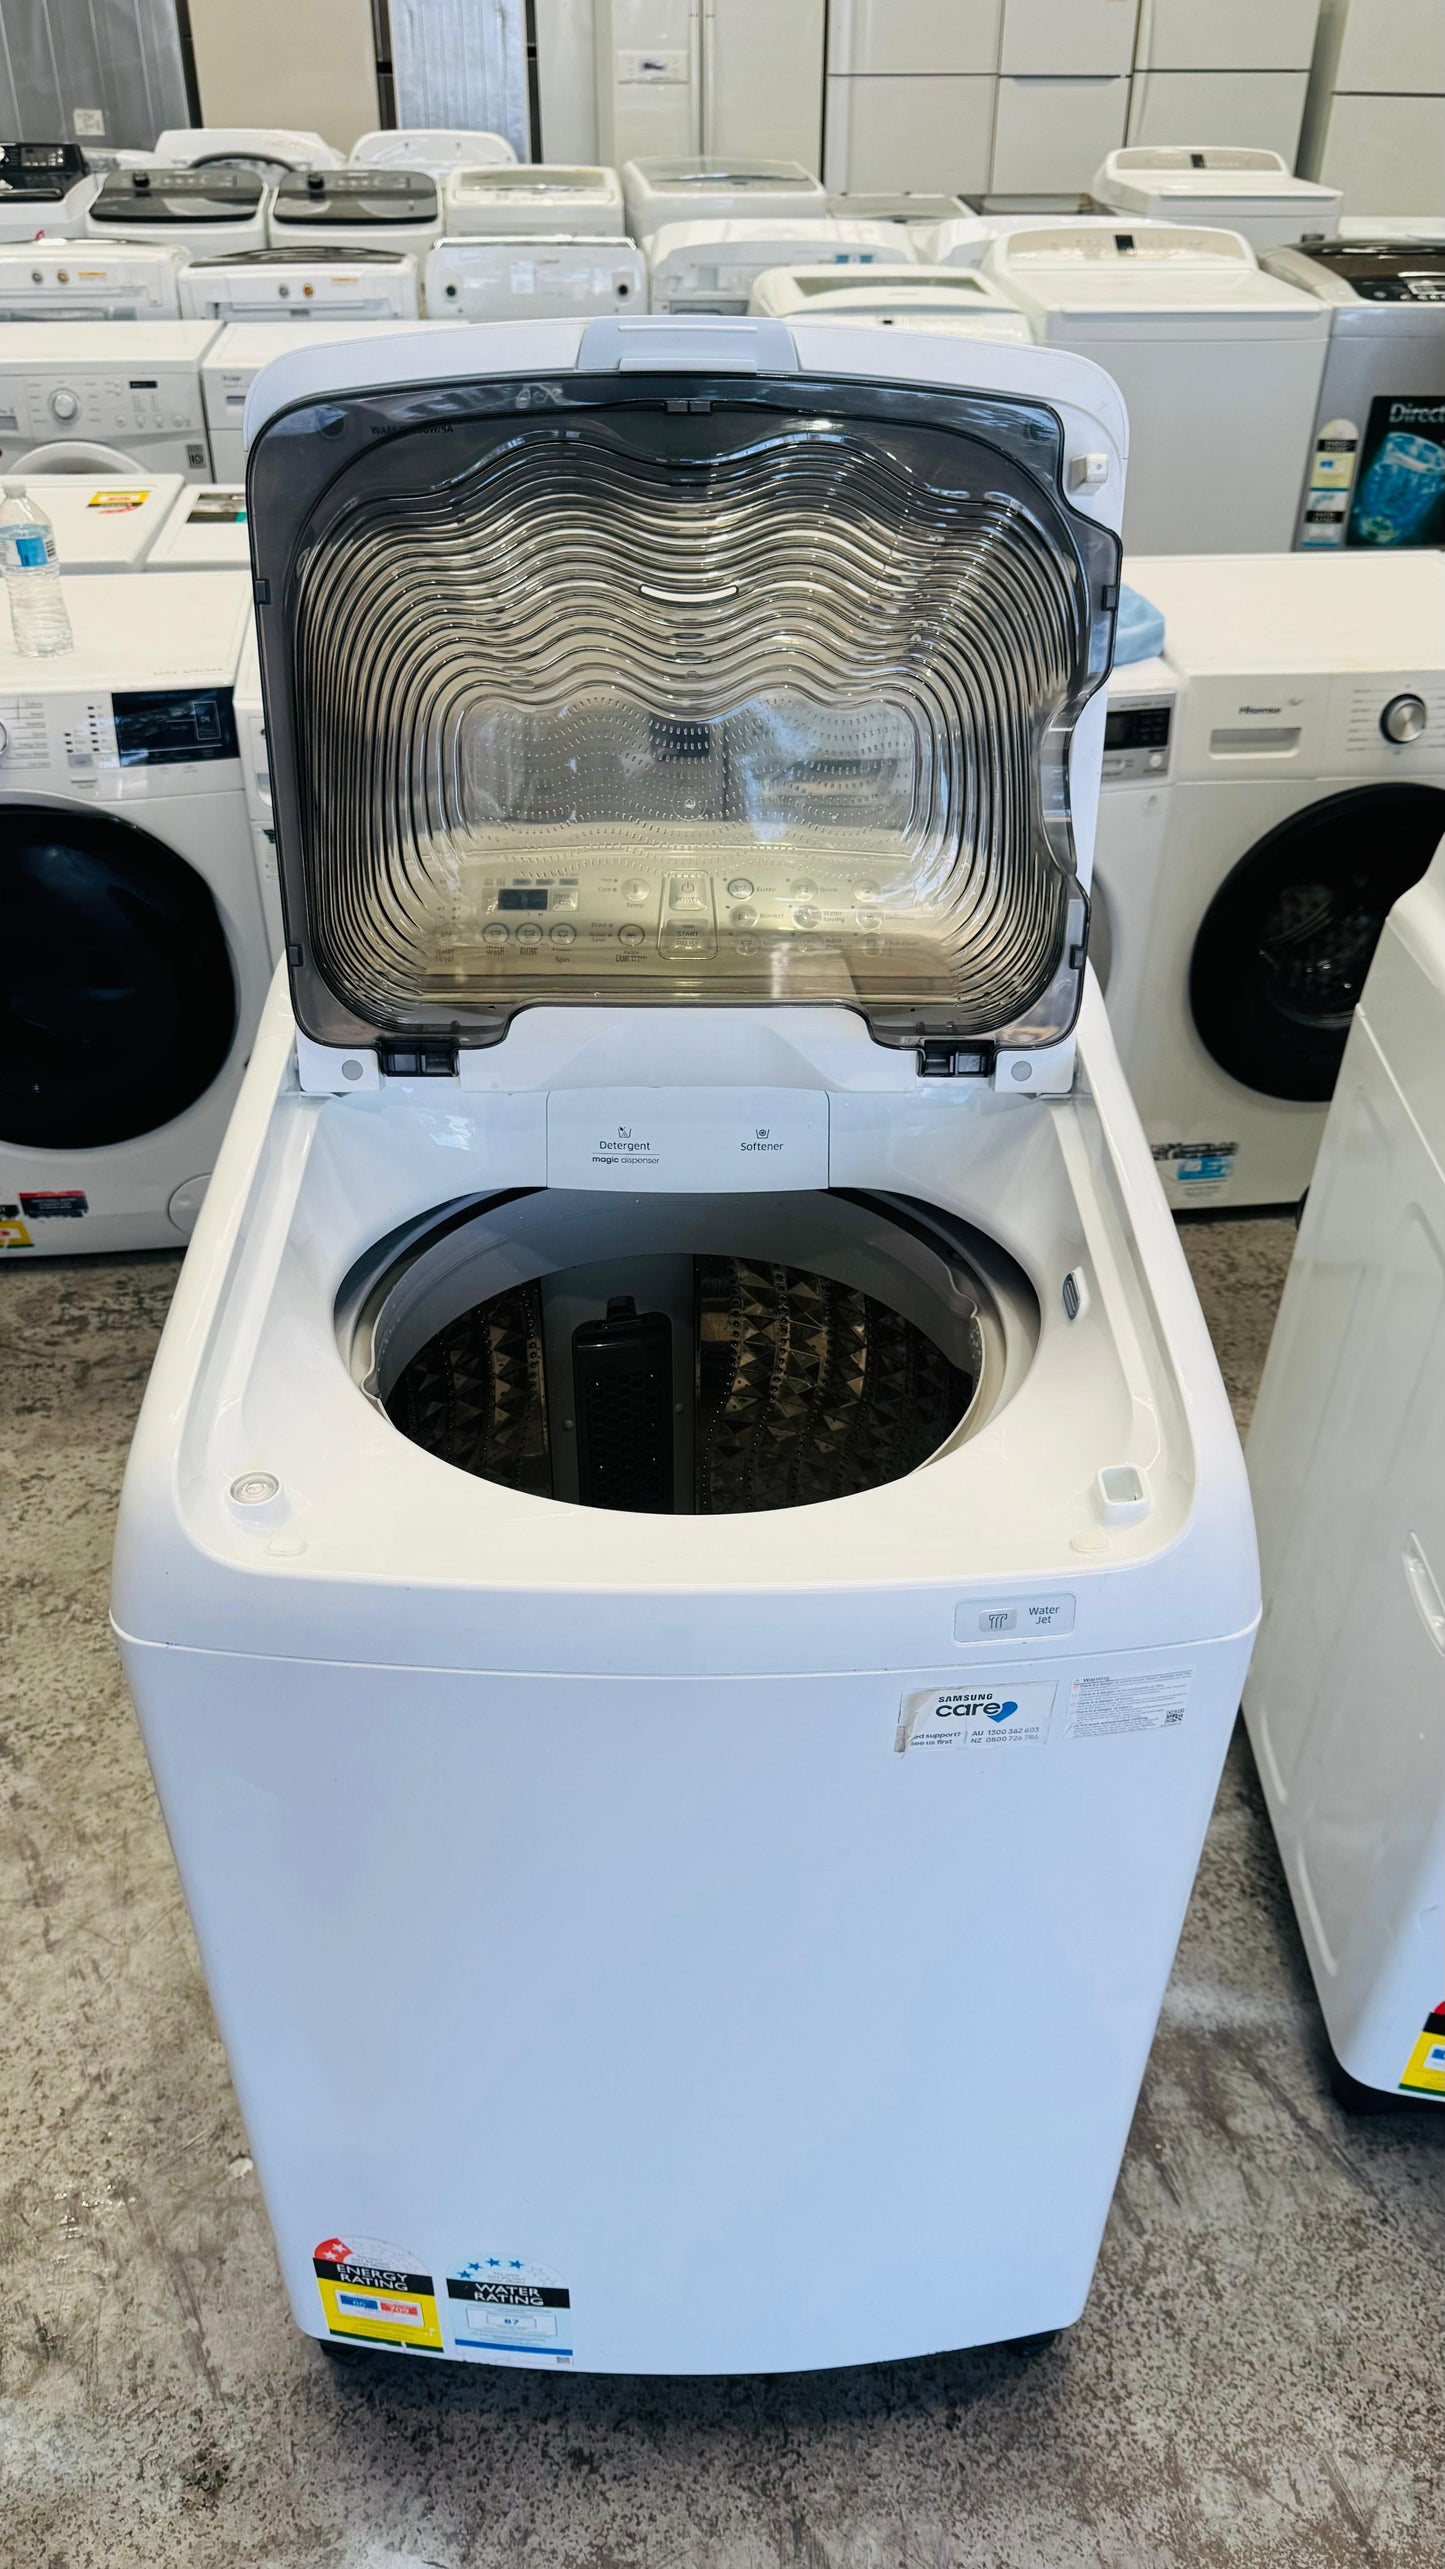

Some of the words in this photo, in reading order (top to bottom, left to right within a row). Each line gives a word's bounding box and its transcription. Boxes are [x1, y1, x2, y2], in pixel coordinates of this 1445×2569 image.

[599, 1141, 650, 1151] Detergent
[740, 1142, 784, 1151] Softener
[592, 1156, 619, 1165] magic
[621, 1156, 660, 1165] dispenser
[1028, 1605, 1061, 1615] Water
[1035, 1615, 1053, 1624] Jet
[938, 1693, 993, 1703] SAMSUNG
[935, 1702, 1001, 1717] care
[925, 1731, 962, 1740] support?
[336, 2263, 408, 2282] ENERGY
[340, 2273, 409, 2291] RATING
[475, 2283, 541, 2297] WATER
[474, 2291, 545, 2306] RATING
